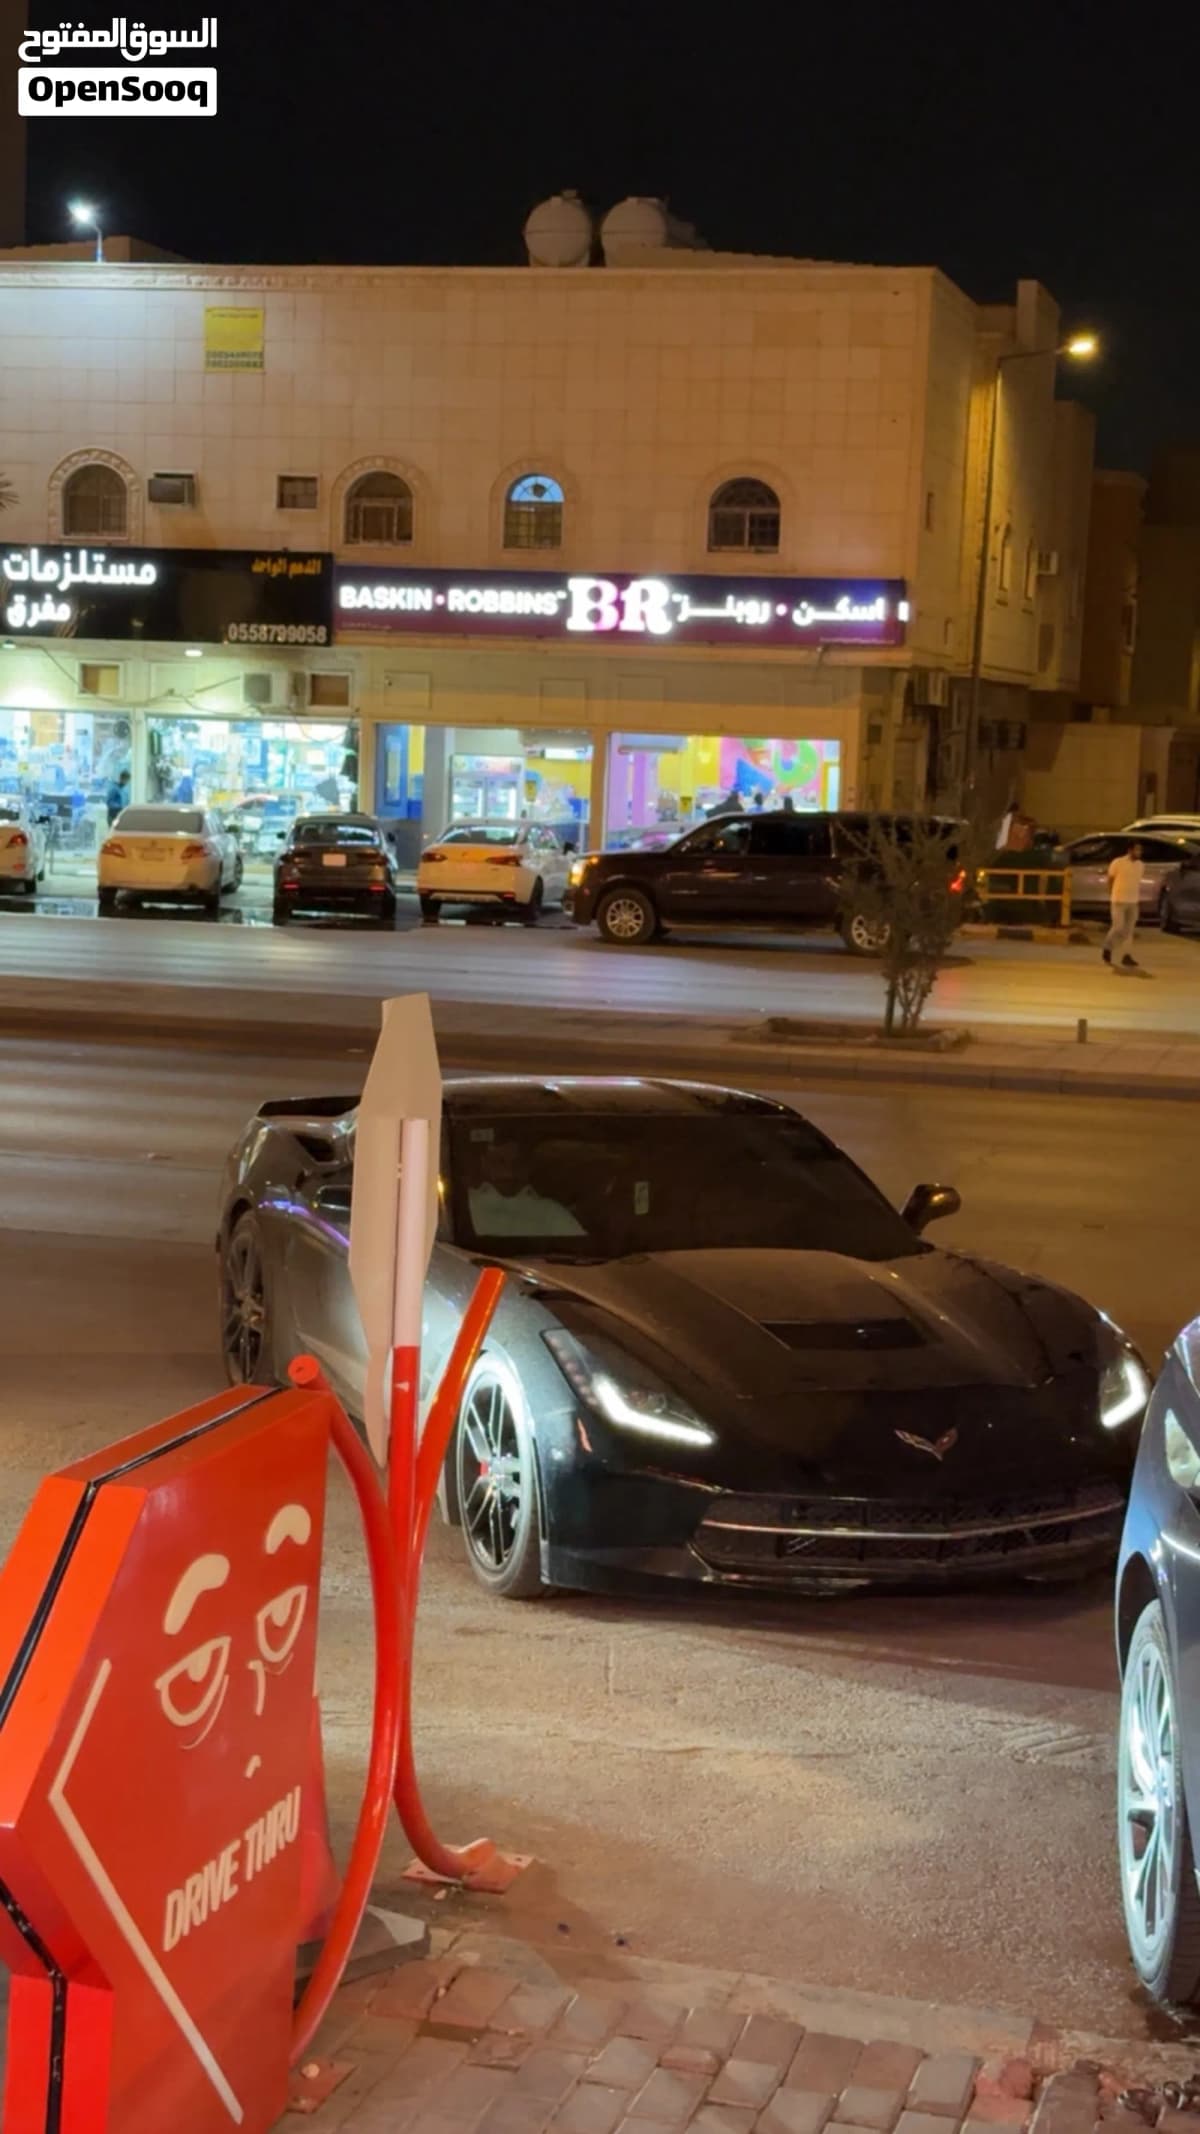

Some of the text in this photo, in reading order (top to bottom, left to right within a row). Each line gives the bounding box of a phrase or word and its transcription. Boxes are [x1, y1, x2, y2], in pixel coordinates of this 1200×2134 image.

[2, 548, 157, 591] مستلزمات
[6, 593, 71, 628] مفرق
[339, 585, 559, 616] BASKIN ROBBINS
[566, 577, 673, 635] BR
[227, 622, 328, 644] 0558799058
[163, 1785, 301, 1952] DRIVE THRU
